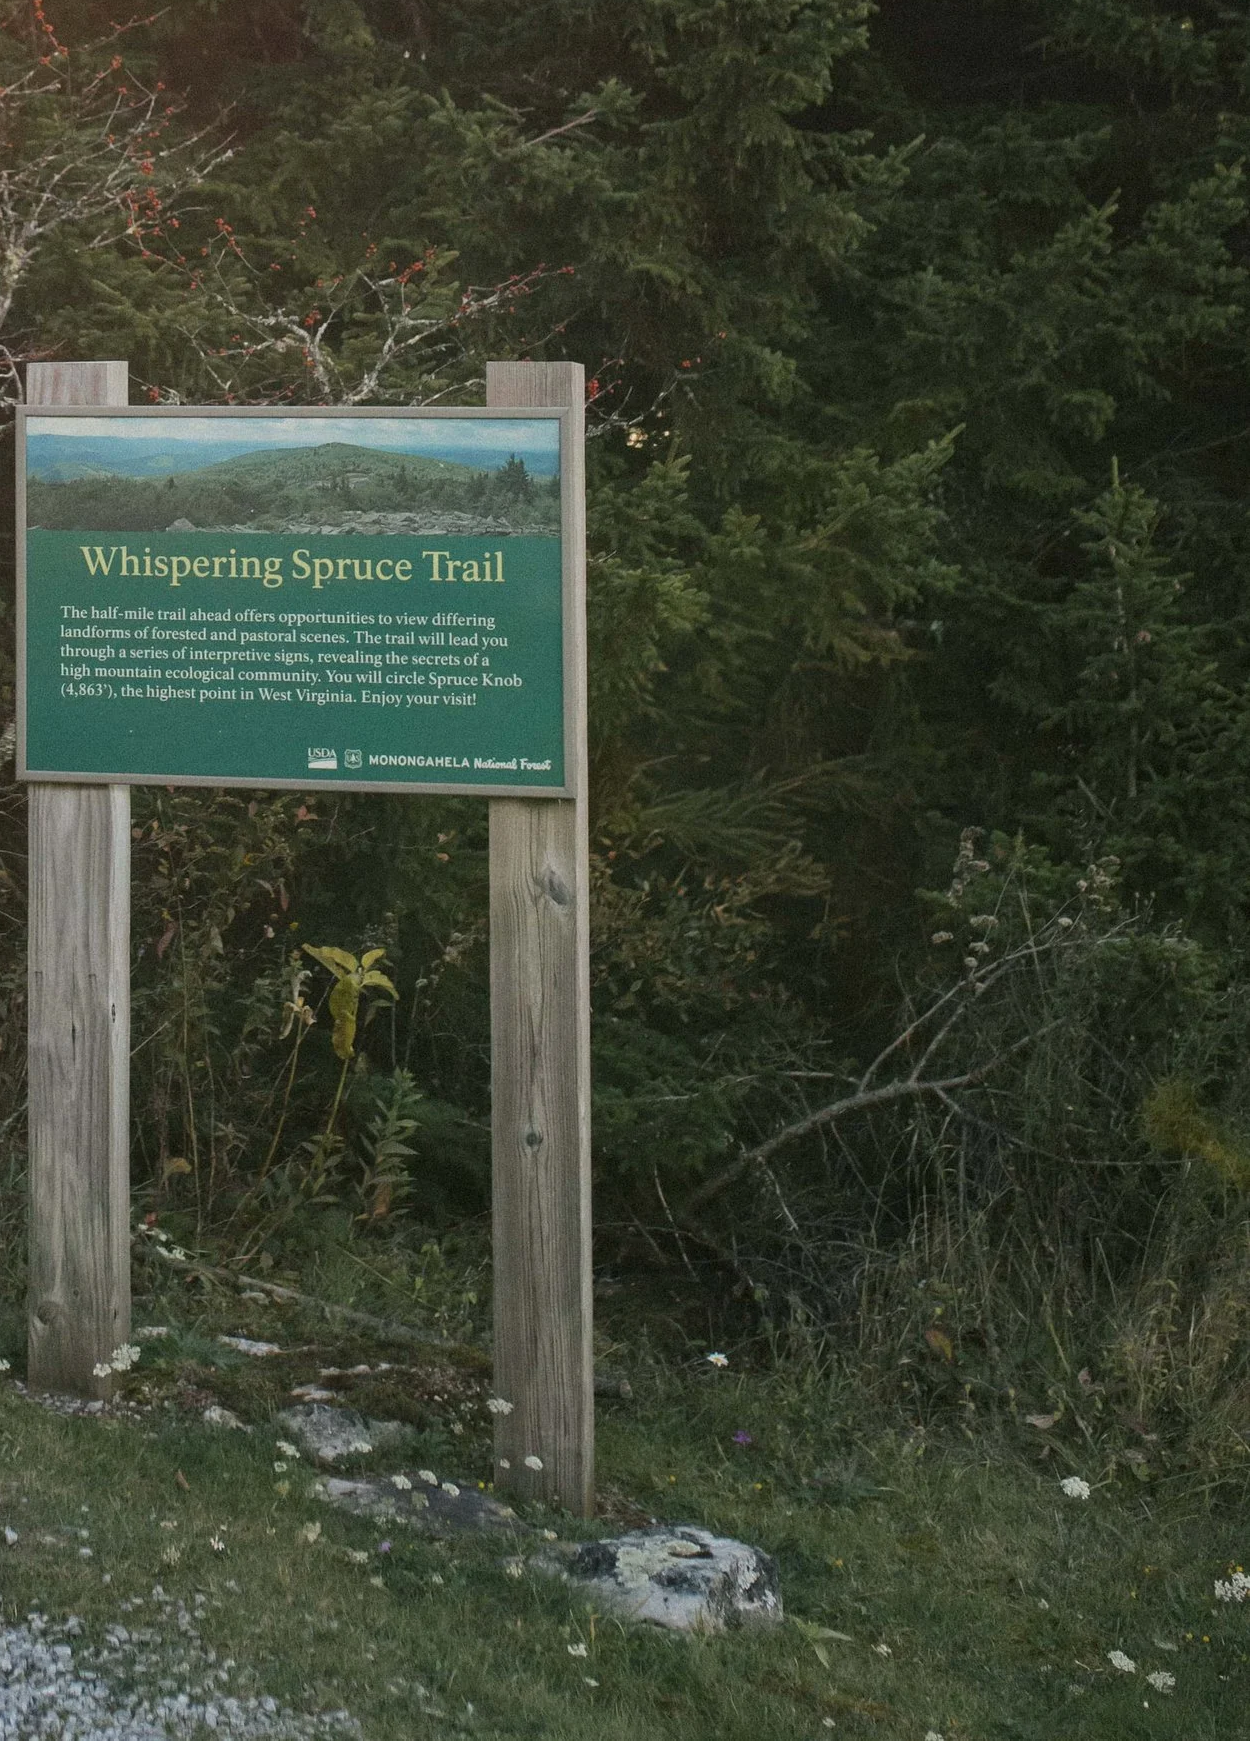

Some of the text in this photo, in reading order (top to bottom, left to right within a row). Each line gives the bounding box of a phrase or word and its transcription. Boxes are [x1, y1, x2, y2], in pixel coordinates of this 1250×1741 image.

[79, 546, 505, 589] Whispering Spruce Trail
[60, 605, 496, 630] The half-mile trail ahead offers opportunities to view differing
[60, 624, 508, 650] landforms of forested and pastoral scenes. The trail will lead you
[60, 644, 490, 668] through a series of interpretive signs, revealing the secrets of a
[60, 663, 523, 689] high mountain ecological community. You will circle Spruce Knob
[120, 684, 144, 698] the
[146, 685, 196, 702] highest
[199, 687, 237, 703] point
[240, 687, 254, 700] in
[258, 687, 292, 701] West
[295, 688, 357, 706] Virginia.
[361, 690, 403, 707] Enjoy
[406, 694, 440, 708] your
[442, 692, 477, 706] visit!
[308, 748, 337, 759] USDA
[369, 755, 470, 768] MONONGAHELA
[473, 758, 518, 770] National
[519, 758, 552, 771] Forest
